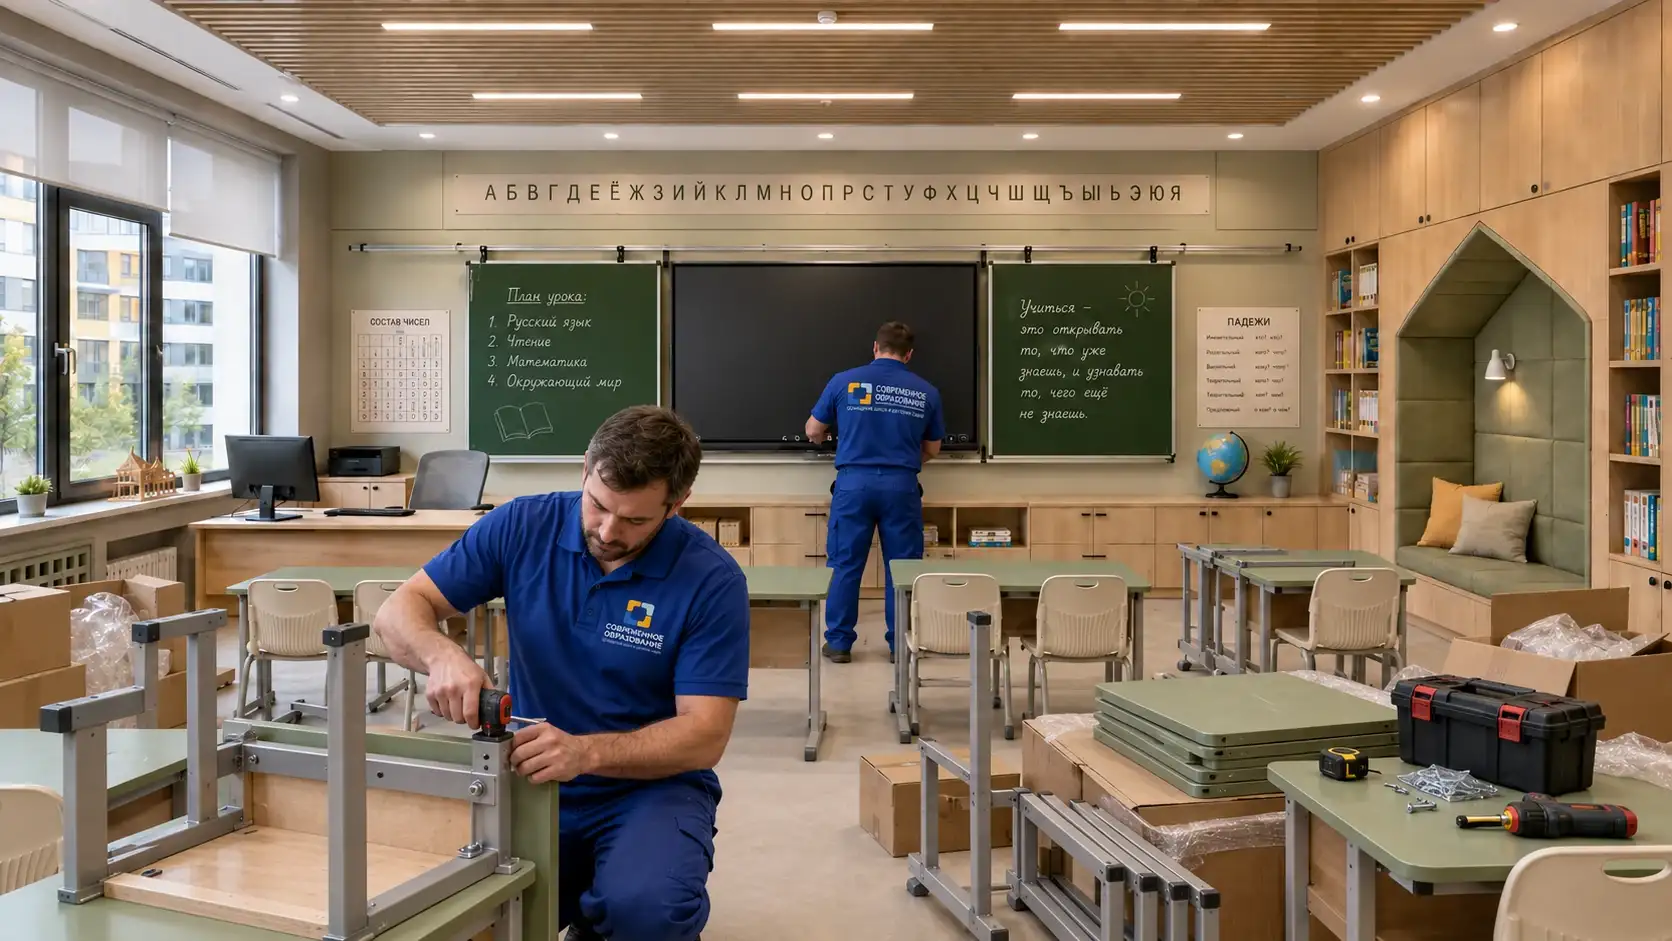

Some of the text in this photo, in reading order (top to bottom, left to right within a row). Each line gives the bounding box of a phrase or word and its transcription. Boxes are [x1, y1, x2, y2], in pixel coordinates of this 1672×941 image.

[506, 287, 587, 306] План урока:
[1019, 299, 1076, 319] Учиться
[369, 317, 430, 327] СОСТАВ ЧИСЕЛ
[488, 314, 592, 332] 1. Русский язык
[1020, 321, 1123, 338] это открывать
[1227, 317, 1271, 328] ПАДЕЖИ
[487, 334, 551, 348] 2. Чтение
[487, 354, 588, 367] 3. Математика
[1020, 345, 1106, 361] то, что уже
[1018, 363, 1144, 382] знаешь, и узнавать
[487, 373, 622, 391] 4. Окружающий мир
[1020, 386, 1109, 400] то, чего ещё
[1019, 410, 1089, 424] не знаешь.
